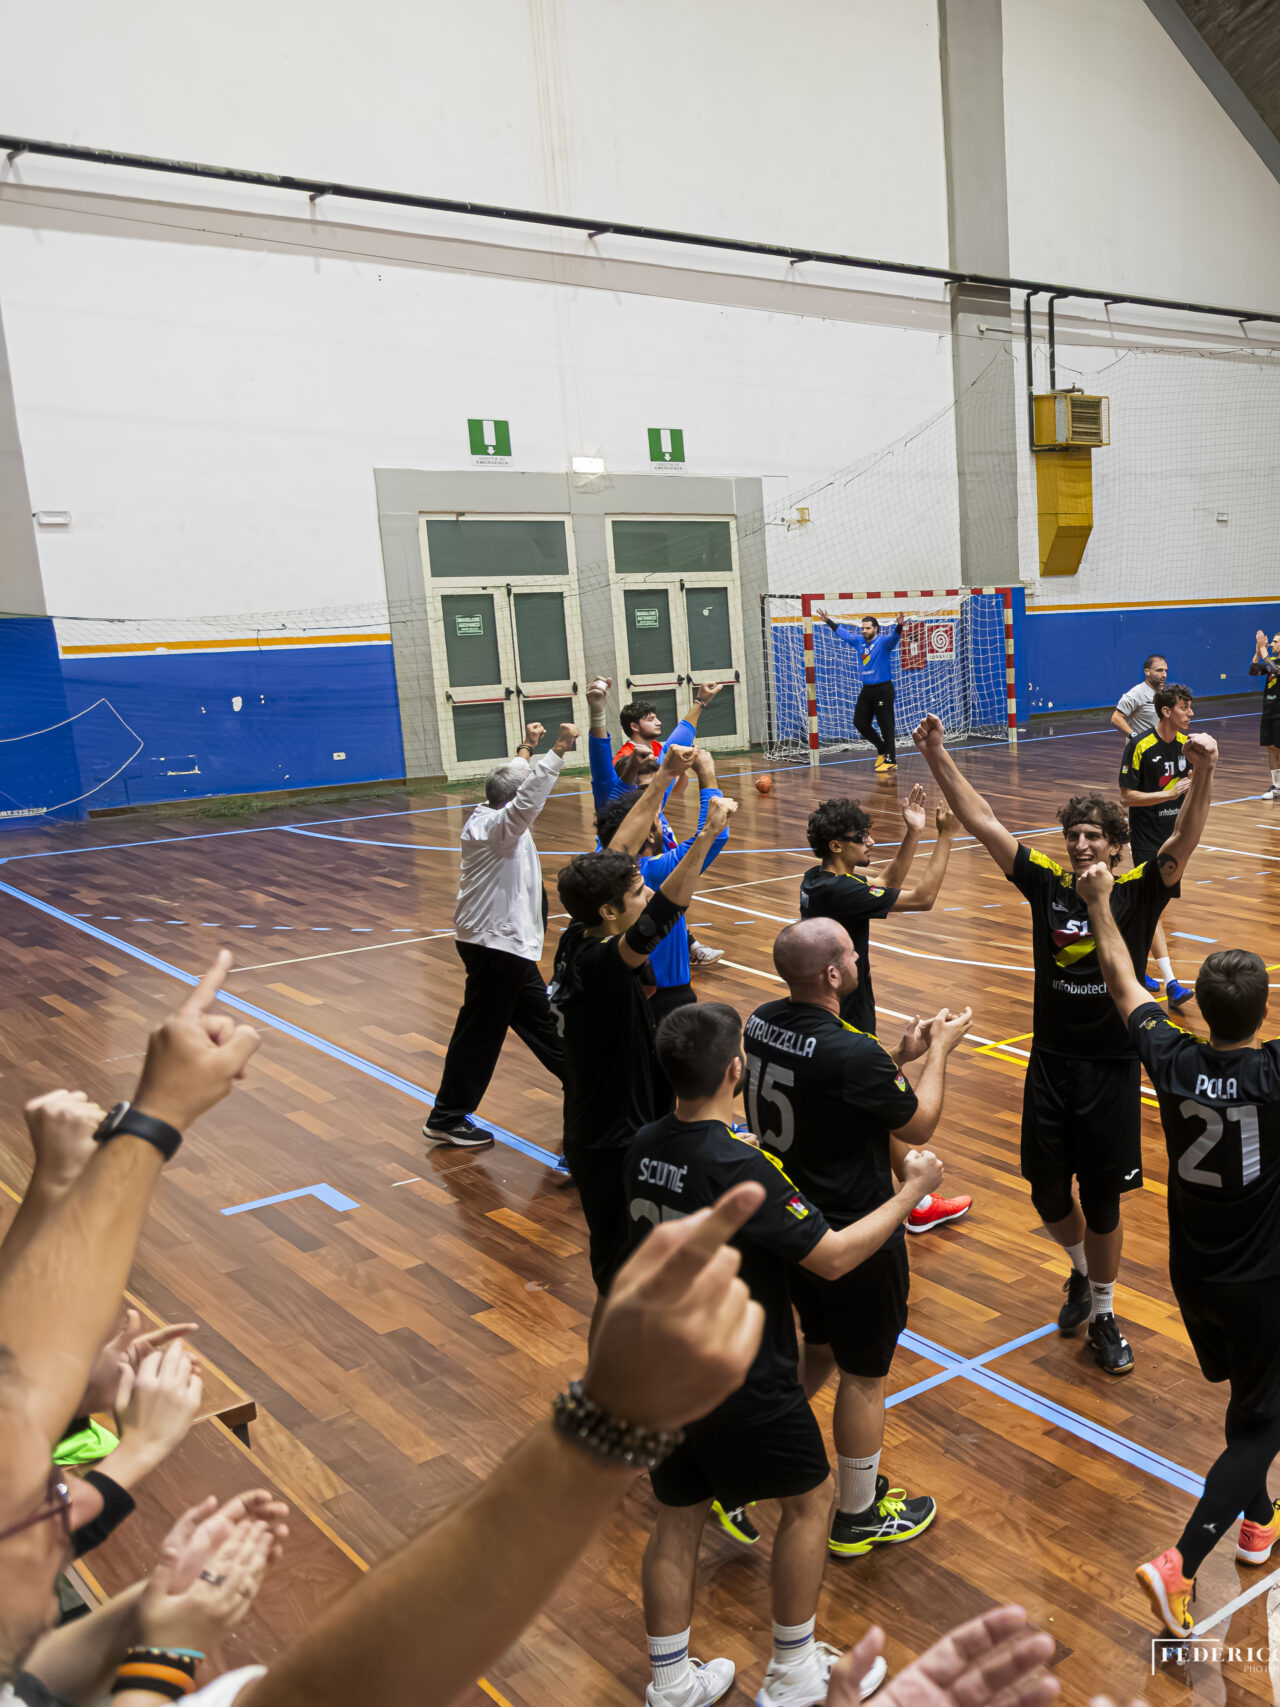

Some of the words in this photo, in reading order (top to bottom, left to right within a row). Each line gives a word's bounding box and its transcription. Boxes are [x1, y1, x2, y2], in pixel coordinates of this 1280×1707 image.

[1164, 761, 1175, 776] 31
[1066, 919, 1088, 936] 51
[1195, 1073, 1238, 1099] POLA
[746, 1052, 795, 1153] 15
[1177, 1099, 1261, 1188] 21
